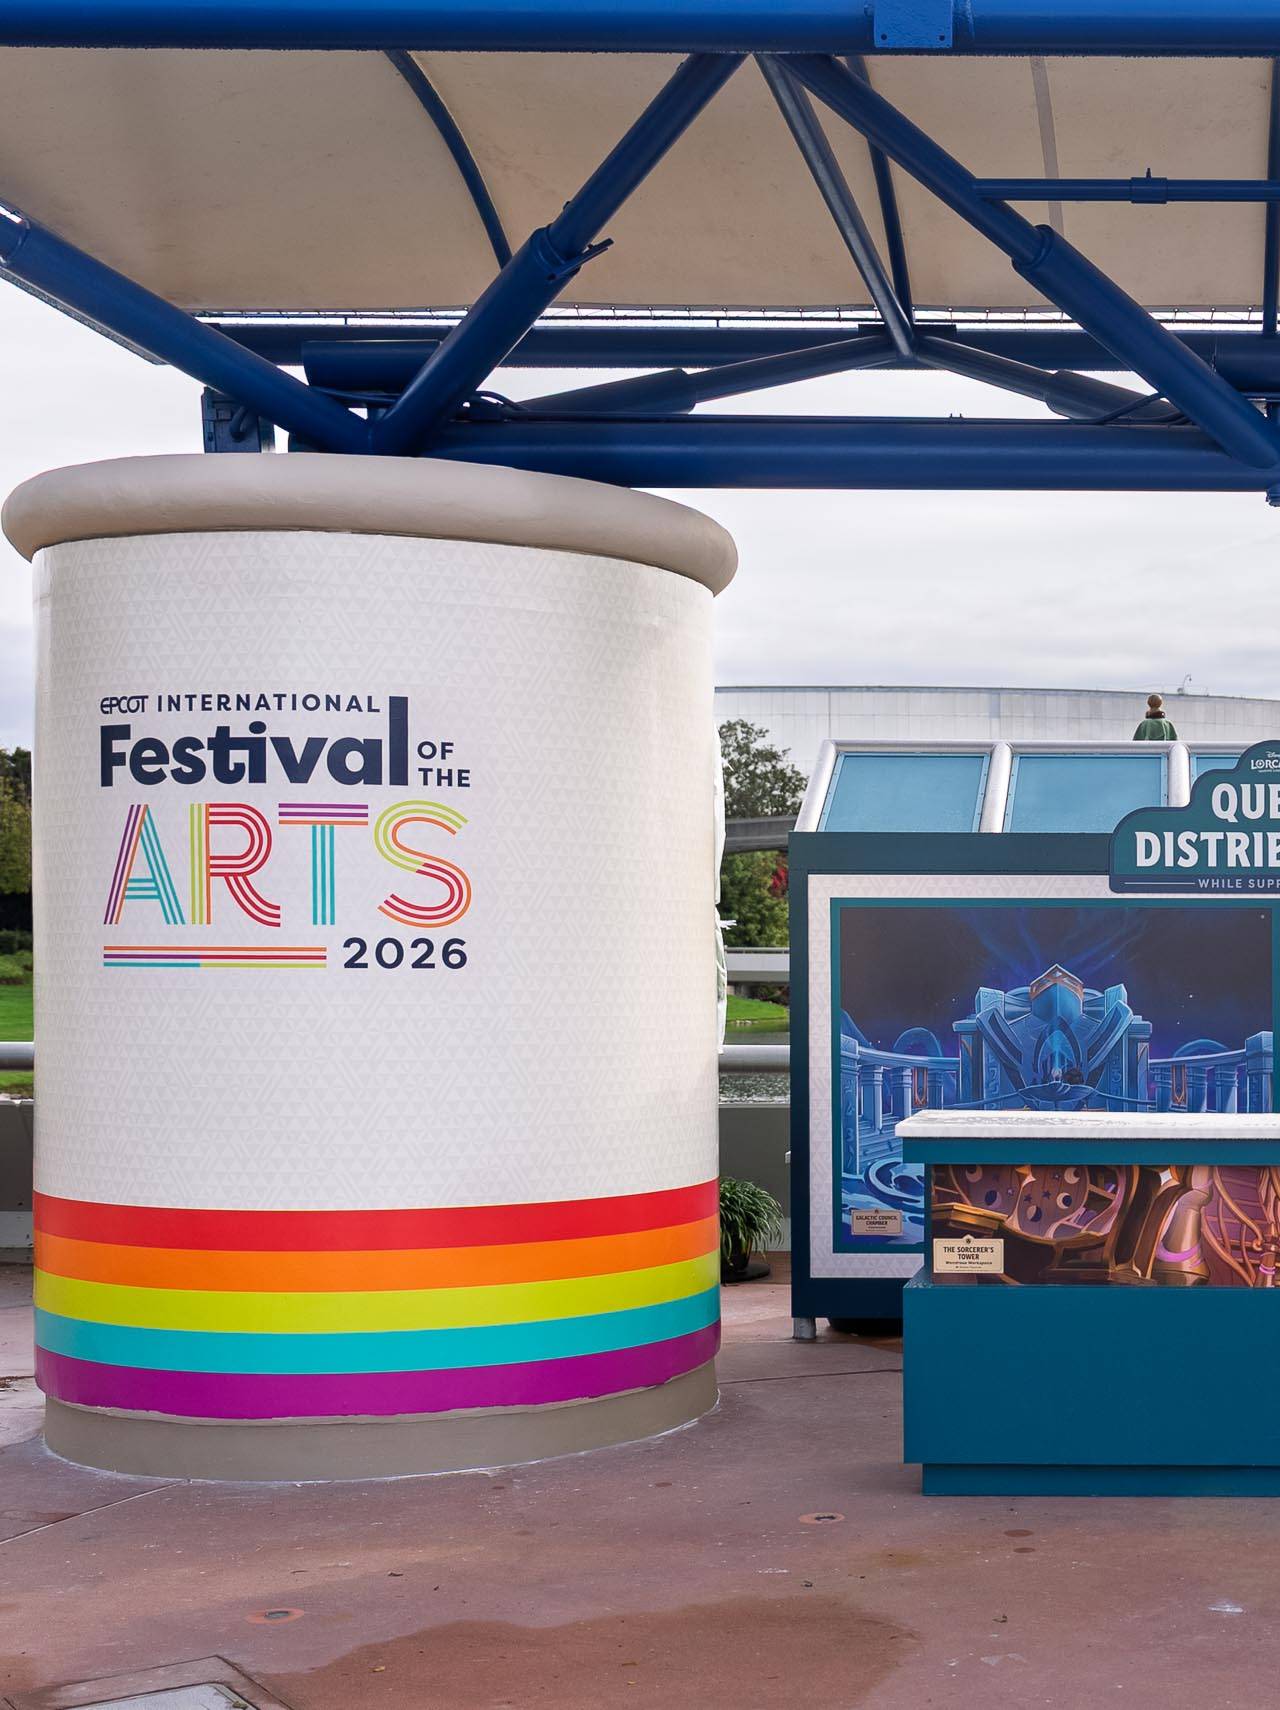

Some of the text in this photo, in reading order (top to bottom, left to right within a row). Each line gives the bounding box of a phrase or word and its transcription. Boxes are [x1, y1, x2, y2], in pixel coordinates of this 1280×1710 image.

[100, 694, 381, 714] EPCOT INTERNATIONAL
[100, 696, 409, 787] Festival
[417, 741, 455, 760] OF
[418, 767, 471, 787] THE
[103, 800, 472, 928] ARTS
[1198, 879, 1243, 889] WHILE
[343, 937, 469, 970] 2026
